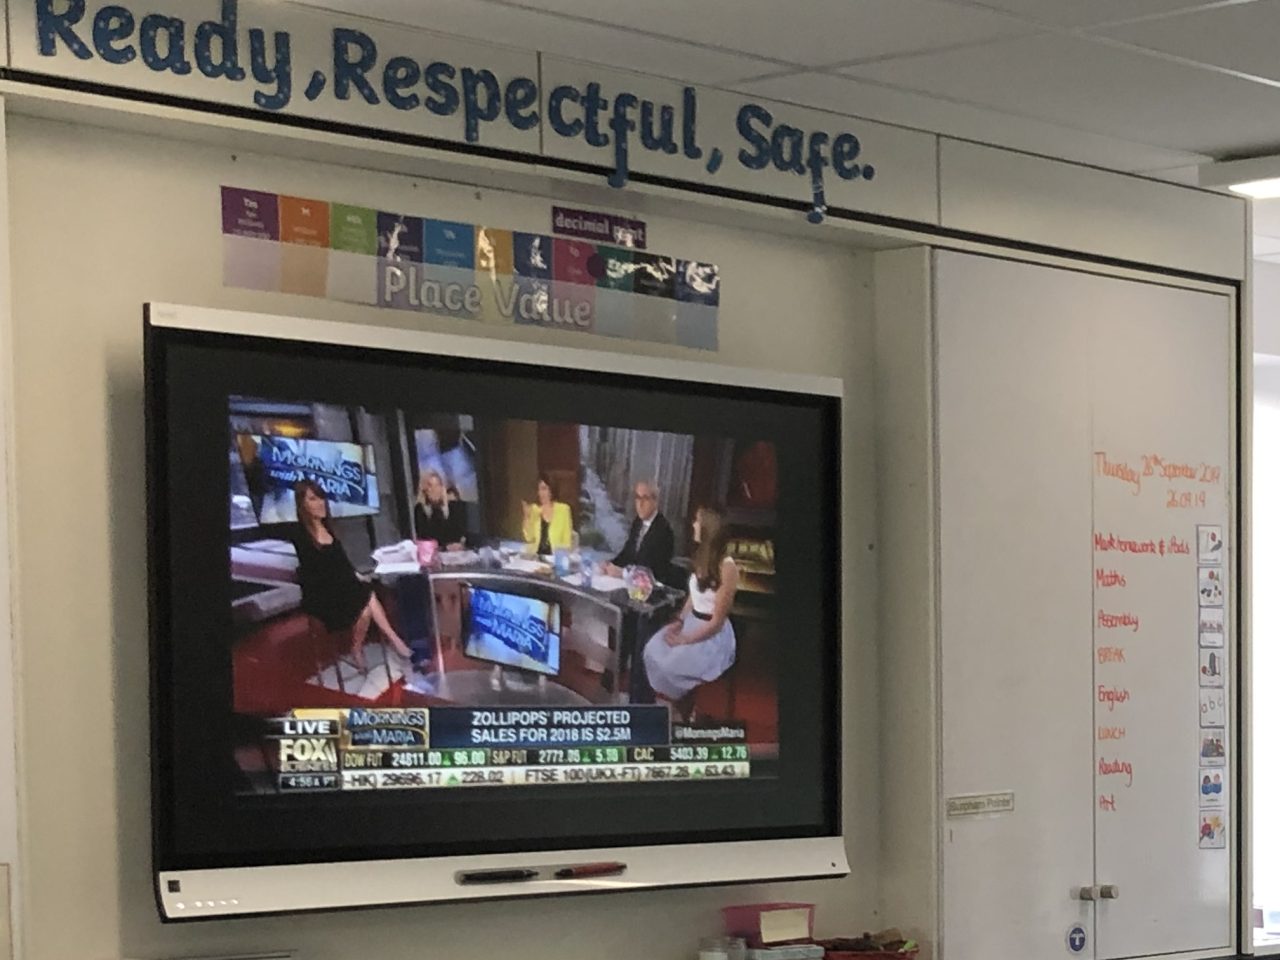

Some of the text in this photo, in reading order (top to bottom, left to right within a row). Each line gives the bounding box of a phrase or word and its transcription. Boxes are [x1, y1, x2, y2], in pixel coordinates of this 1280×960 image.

[36, 0, 876, 224] Ready, Respectful, Safe.
[555, 210, 610, 234] decimal
[384, 265, 592, 327] Place Value
[272, 446, 362, 481] MORNINGS
[1096, 568, 1127, 588] Maths
[1098, 609, 1139, 632] Assembly
[1098, 684, 1130, 712] English
[284, 720, 331, 735] LIVE
[353, 711, 425, 726] MORNINGS
[472, 711, 631, 726] ZOLLIPOPS' PROJECTED
[373, 730, 415, 744] MARIA
[471, 729, 517, 743] SALES
[519, 728, 547, 742] FOR
[582, 727, 594, 741] IS
[280, 738, 328, 762] FOX
[634, 747, 655, 761] CAC
[345, 752, 365, 768] DOW
[366, 752, 383, 767] FUT
[525, 769, 559, 783] FTSE
